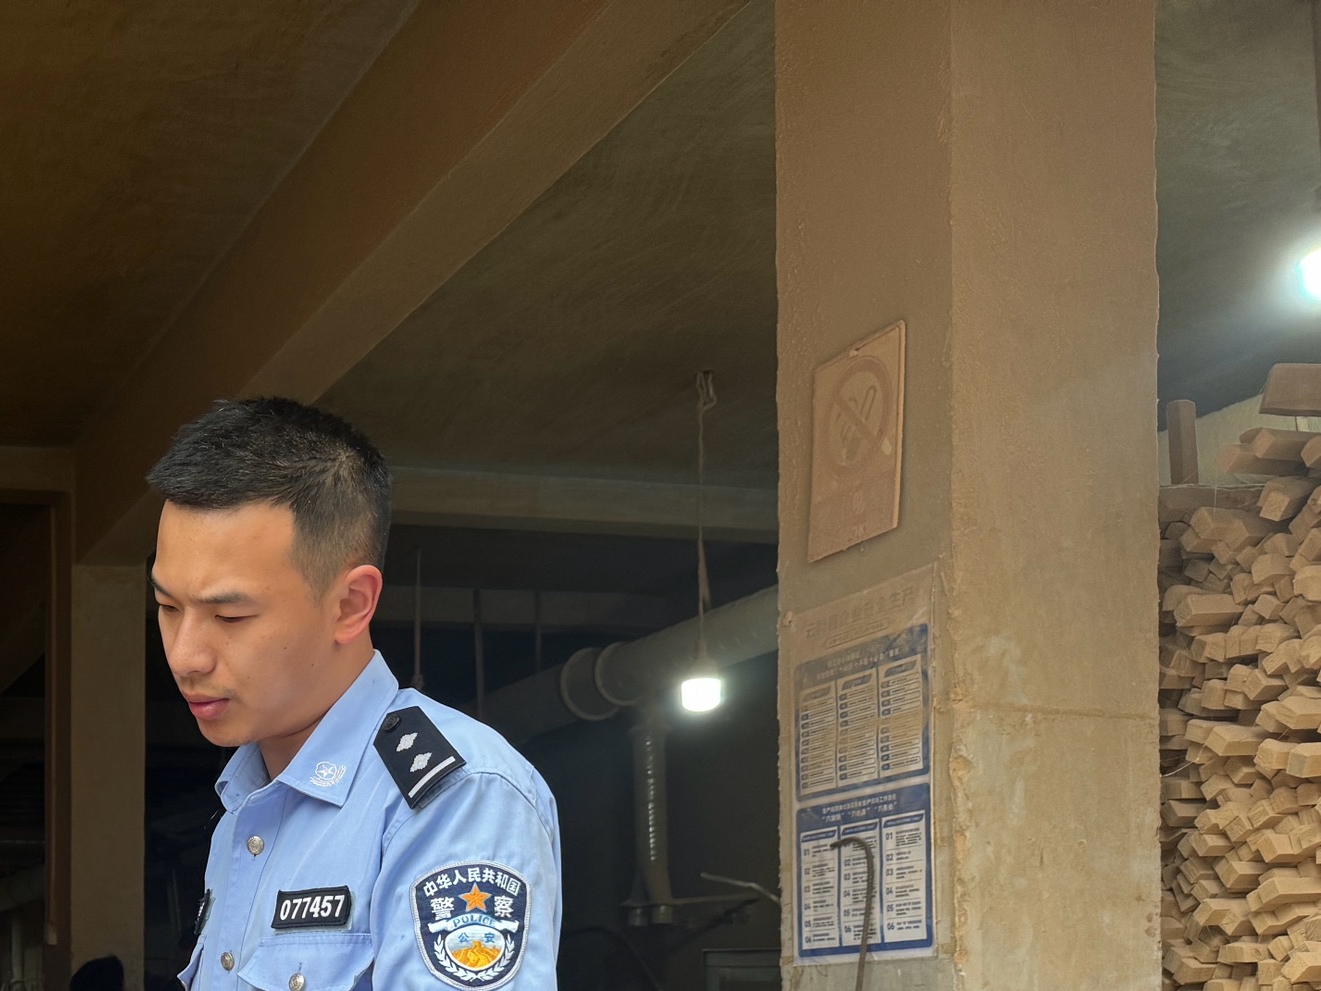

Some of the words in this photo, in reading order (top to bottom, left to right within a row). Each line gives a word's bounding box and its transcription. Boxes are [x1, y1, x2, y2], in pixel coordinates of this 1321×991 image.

[423, 867, 521, 897] 中华人民共和国
[279, 894, 345, 921] 077457
[430, 896, 455, 920] 警
[493, 895, 514, 918] 察
[452, 913, 496, 928] POLICE
[457, 932, 496, 944] 公安
